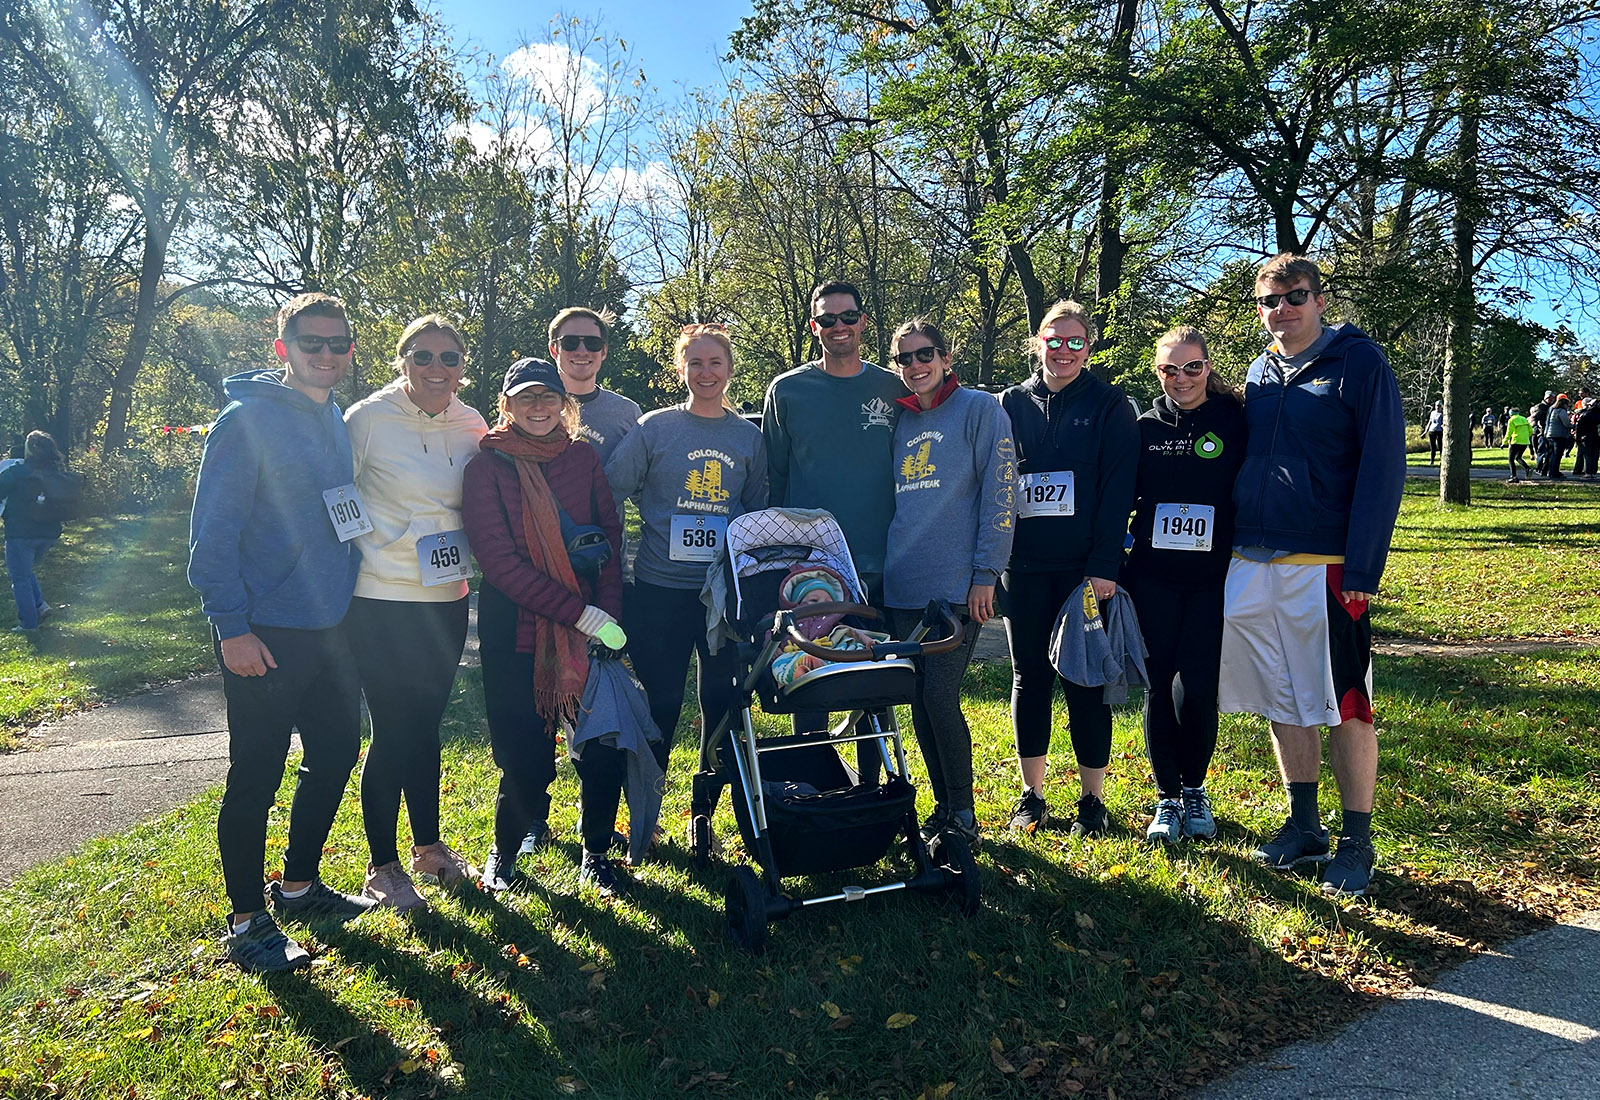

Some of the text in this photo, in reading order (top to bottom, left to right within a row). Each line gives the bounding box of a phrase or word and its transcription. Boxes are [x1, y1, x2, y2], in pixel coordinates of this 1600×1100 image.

[907, 431, 944, 447] COLORAMA
[688, 449, 735, 469] COLORAMA
[920, 479, 941, 489] PEAK
[1024, 484, 1068, 504] 1927
[330, 499, 361, 526] 1910
[1161, 516, 1207, 537] 1940
[682, 528, 717, 548] 536
[430, 545, 461, 569] 459
